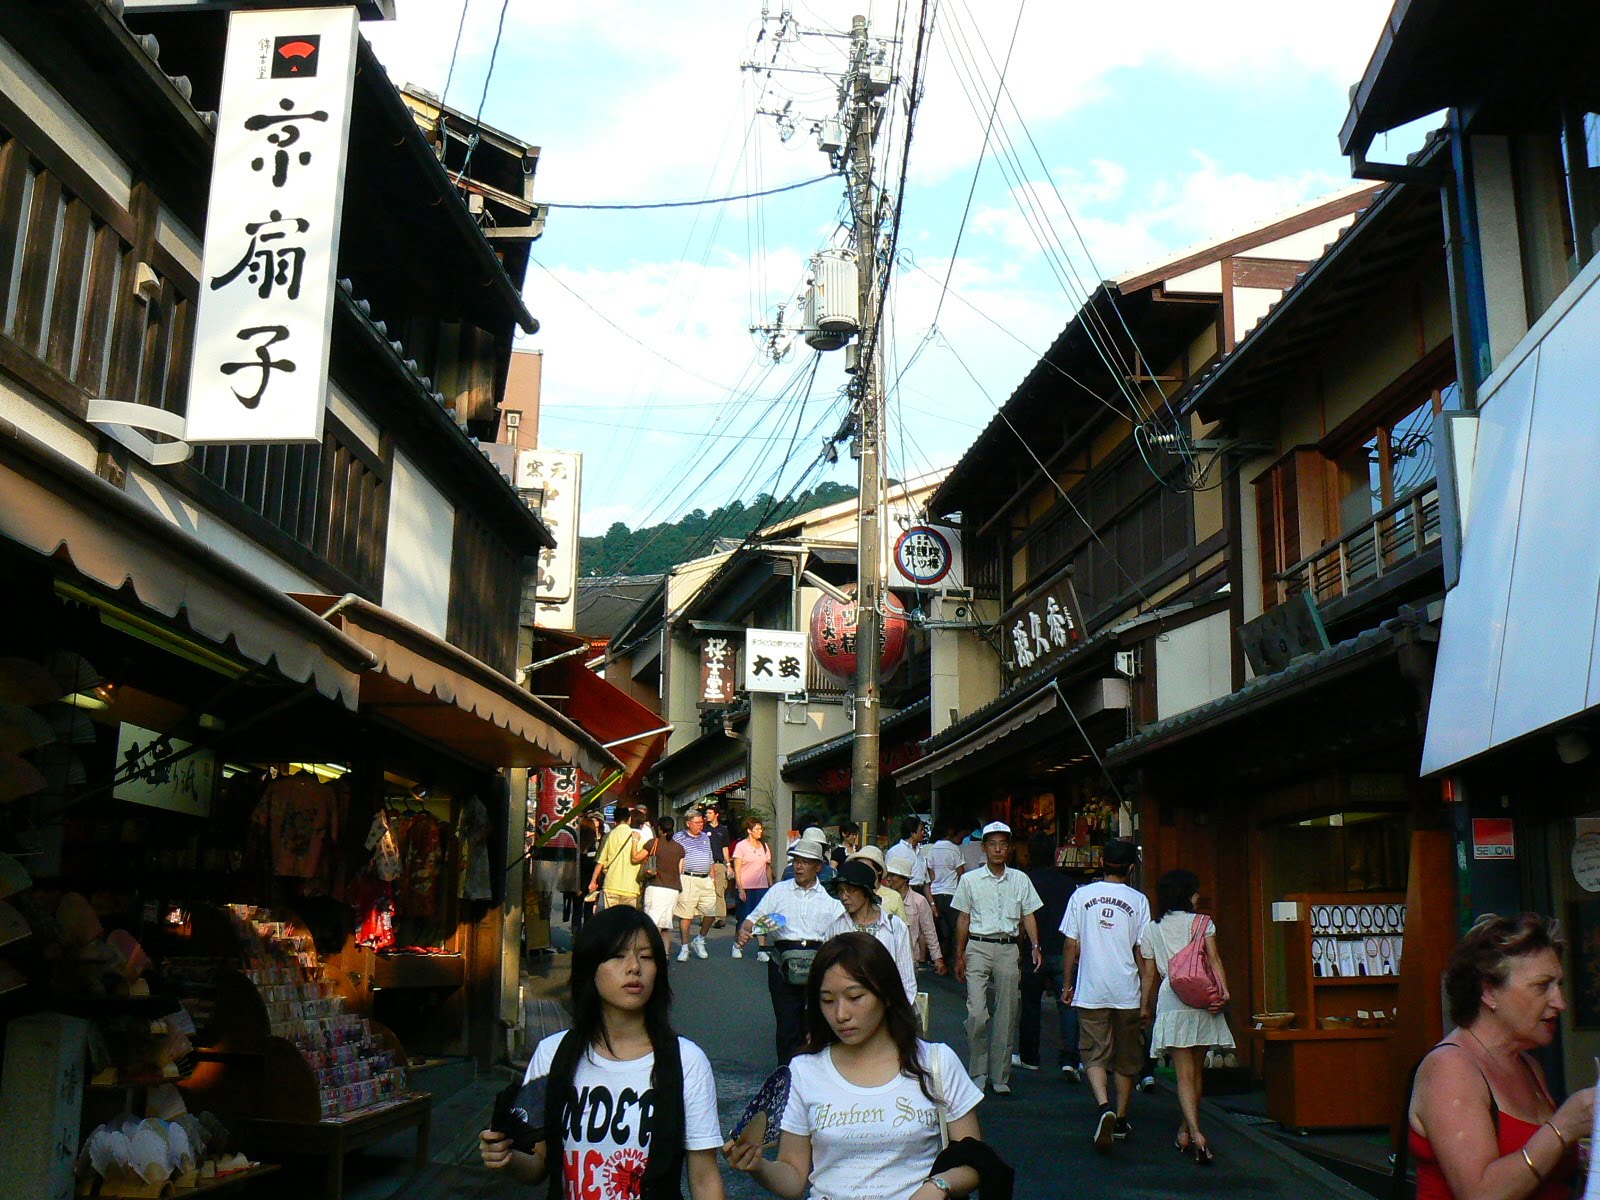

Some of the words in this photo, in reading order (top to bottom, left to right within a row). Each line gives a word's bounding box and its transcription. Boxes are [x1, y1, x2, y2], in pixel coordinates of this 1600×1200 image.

[210, 98, 329, 409] 京扇子
[752, 654, 801, 679] 大安
[1476, 846, 1513, 856] SEOM
[562, 1085, 657, 1148] NDER
